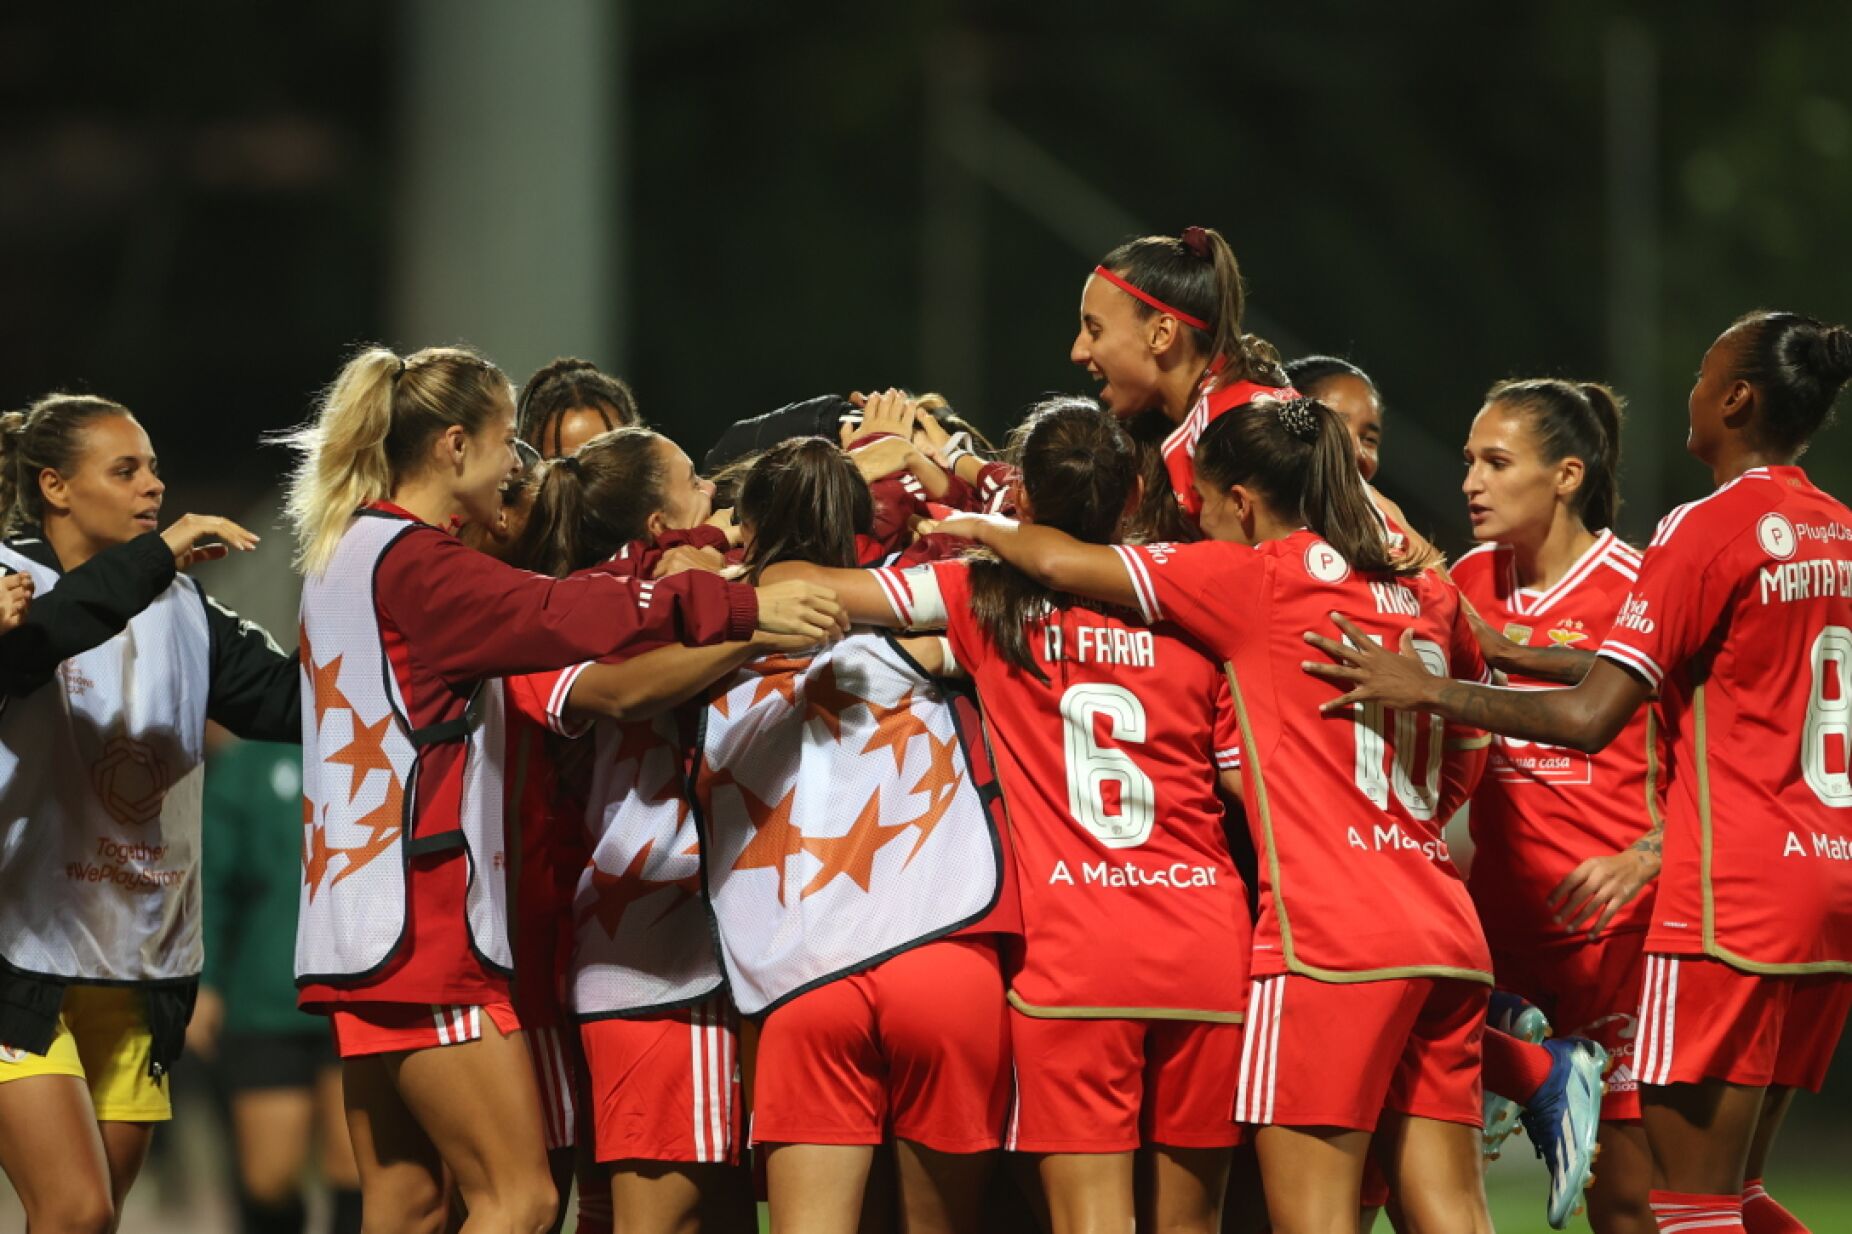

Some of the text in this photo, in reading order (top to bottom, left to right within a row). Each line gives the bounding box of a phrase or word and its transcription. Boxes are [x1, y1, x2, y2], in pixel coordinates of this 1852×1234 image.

[1760, 559, 1836, 605] MARTA
[1077, 625, 1155, 668] FARIA
[1342, 634, 1449, 821] 10
[1801, 625, 1852, 808] 8
[1059, 682, 1155, 849] 6
[1538, 757, 1571, 769] casa
[97, 836, 169, 865] Together
[1347, 825, 1368, 851] A
[1783, 831, 1852, 861] A Mat
[1048, 860, 1075, 886] A
